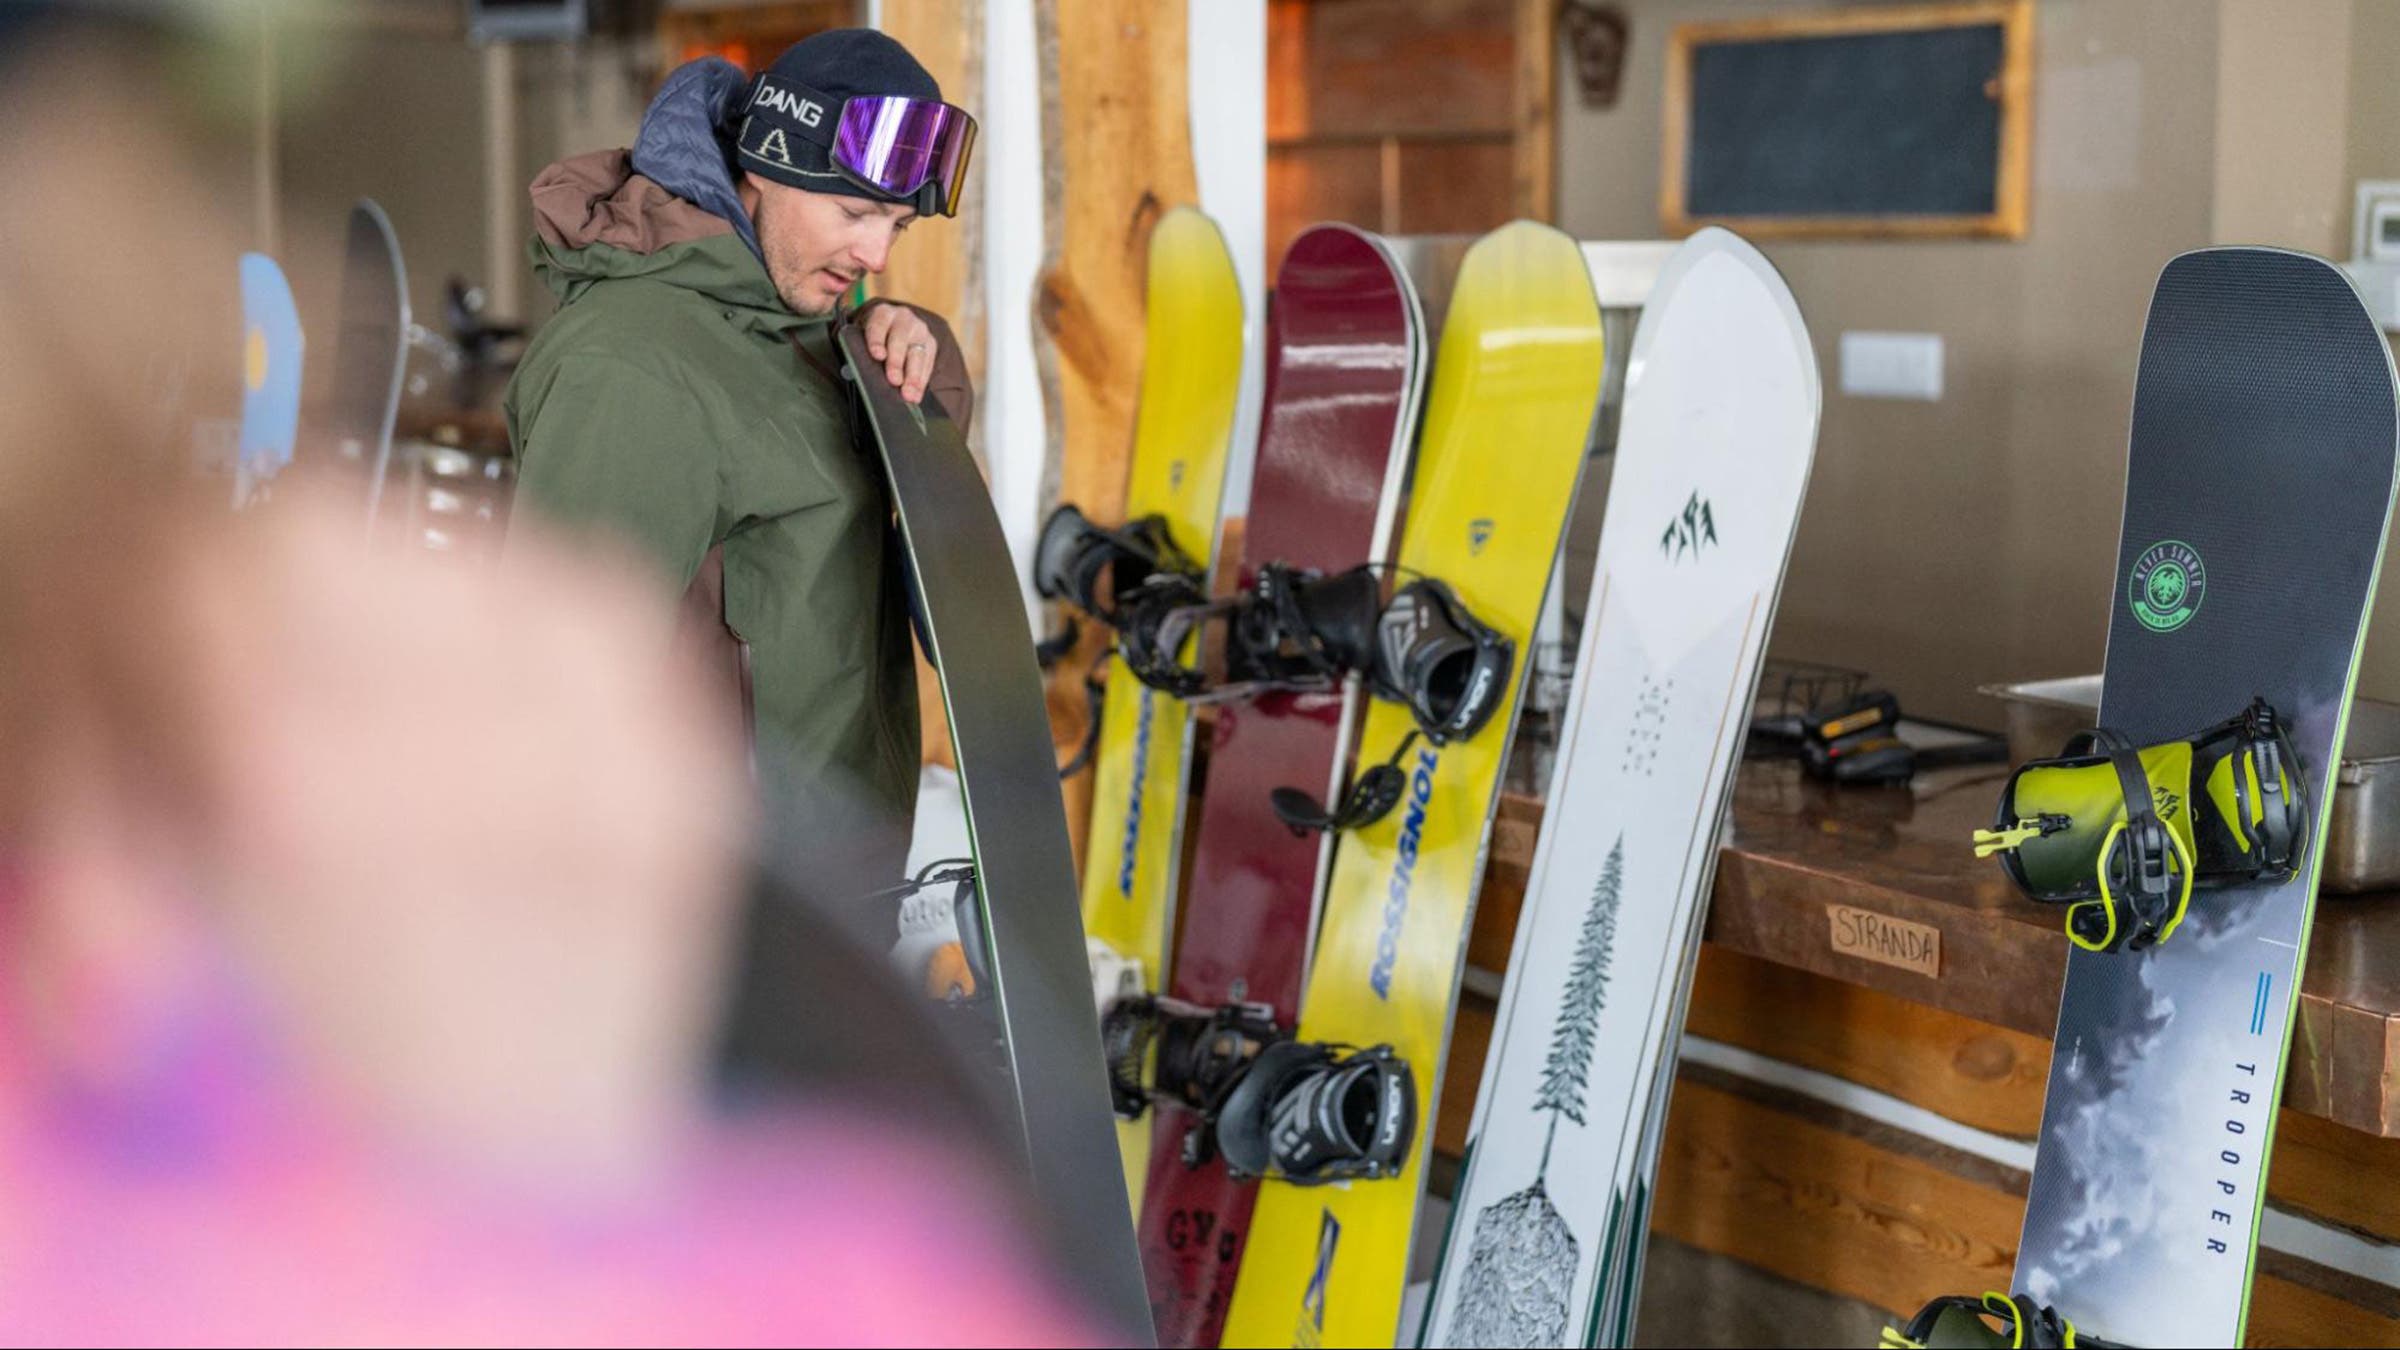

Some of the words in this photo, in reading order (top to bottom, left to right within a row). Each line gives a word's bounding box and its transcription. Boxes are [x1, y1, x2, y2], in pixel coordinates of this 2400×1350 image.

[755, 86, 824, 128] DANG
[755, 128, 793, 165] A
[1370, 748, 1438, 1001] ROSSIGNOL
[1836, 907, 1934, 964] STRANDA
[2206, 1063, 2256, 1254] TROOPER
